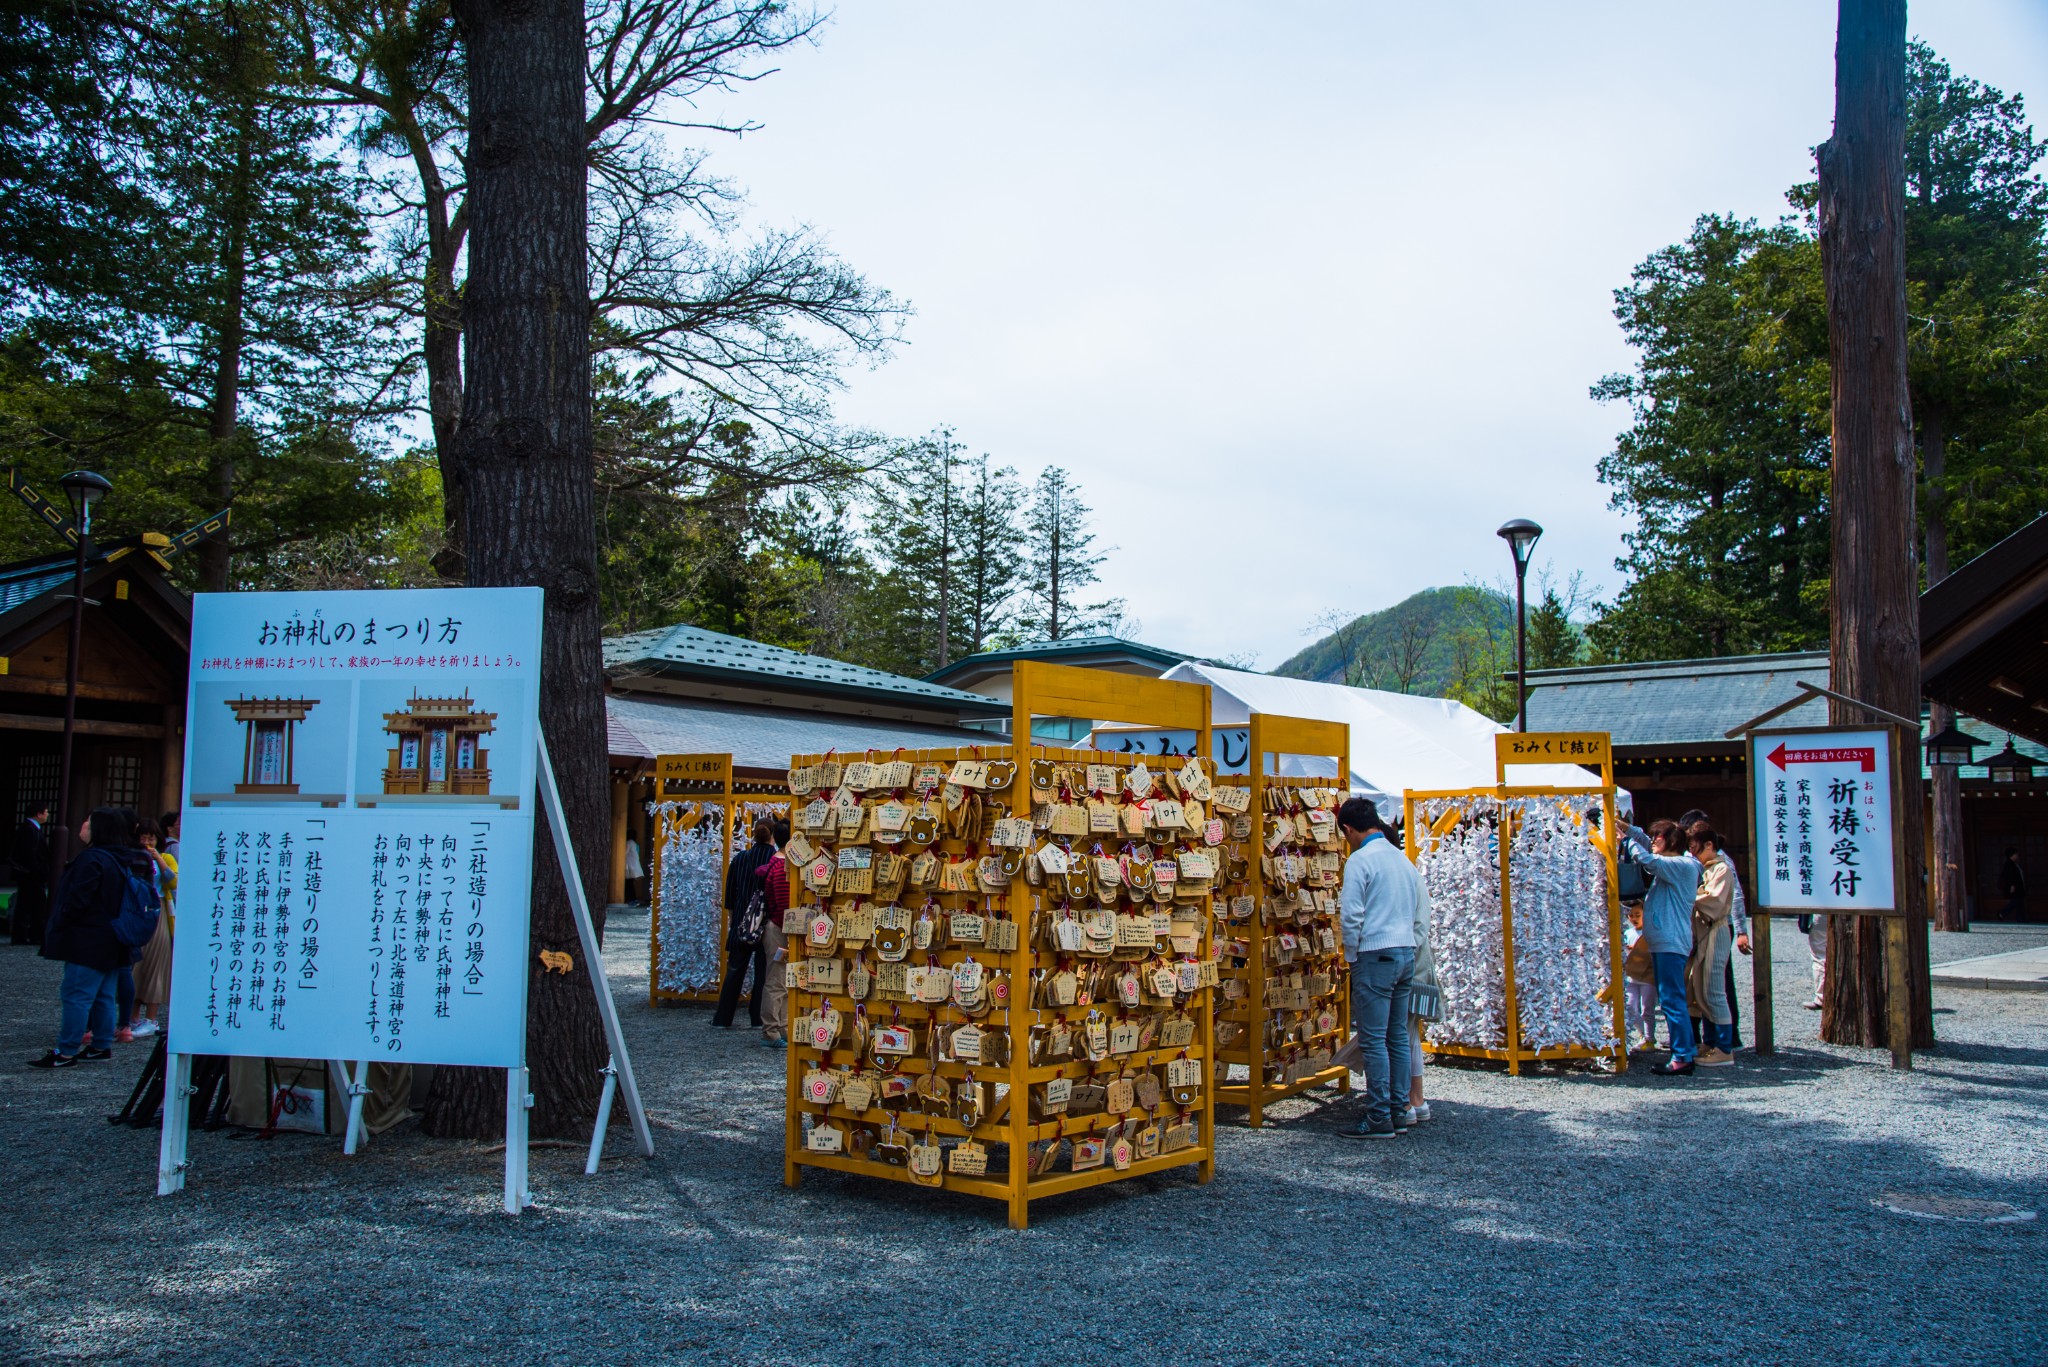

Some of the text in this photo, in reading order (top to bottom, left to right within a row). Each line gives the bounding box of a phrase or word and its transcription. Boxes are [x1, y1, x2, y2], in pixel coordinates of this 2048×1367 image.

[201, 654, 522, 671] お神札を神棚におまつりして、家族の一年の幸せを祈りましょう。
[258, 616, 463, 647] お神札のまつり方
[665, 761, 722, 772] おみくじ結び
[1512, 739, 1600, 755] おみくじ結び
[1784, 750, 1868, 761] 回廊をお通りください
[1864, 780, 1876, 833] おはらい
[1773, 779, 1790, 881] 交通安全・諸祈願
[1796, 779, 1814, 896] 家内安全・商売繁昌
[1827, 777, 1862, 898] 祈祷受付
[204, 831, 227, 1037] を重ねておまつりします。
[225, 831, 249, 1029] 次に北海道神宮のお神札
[248, 831, 271, 1012] 次に氏神神社のお神札
[270, 831, 293, 1031] 手前に伊勢神宮のお神札
[298, 819, 326, 990] 「一社造りの場合」
[365, 834, 388, 1044] お神札をおまつりします。
[387, 834, 411, 1052] 向かって左に北海道神宮の
[414, 834, 434, 962] 中央に伊勢神宮
[434, 834, 457, 1018] 向かって右に氏神神社
[463, 821, 491, 996] 「三社造りの場合」
